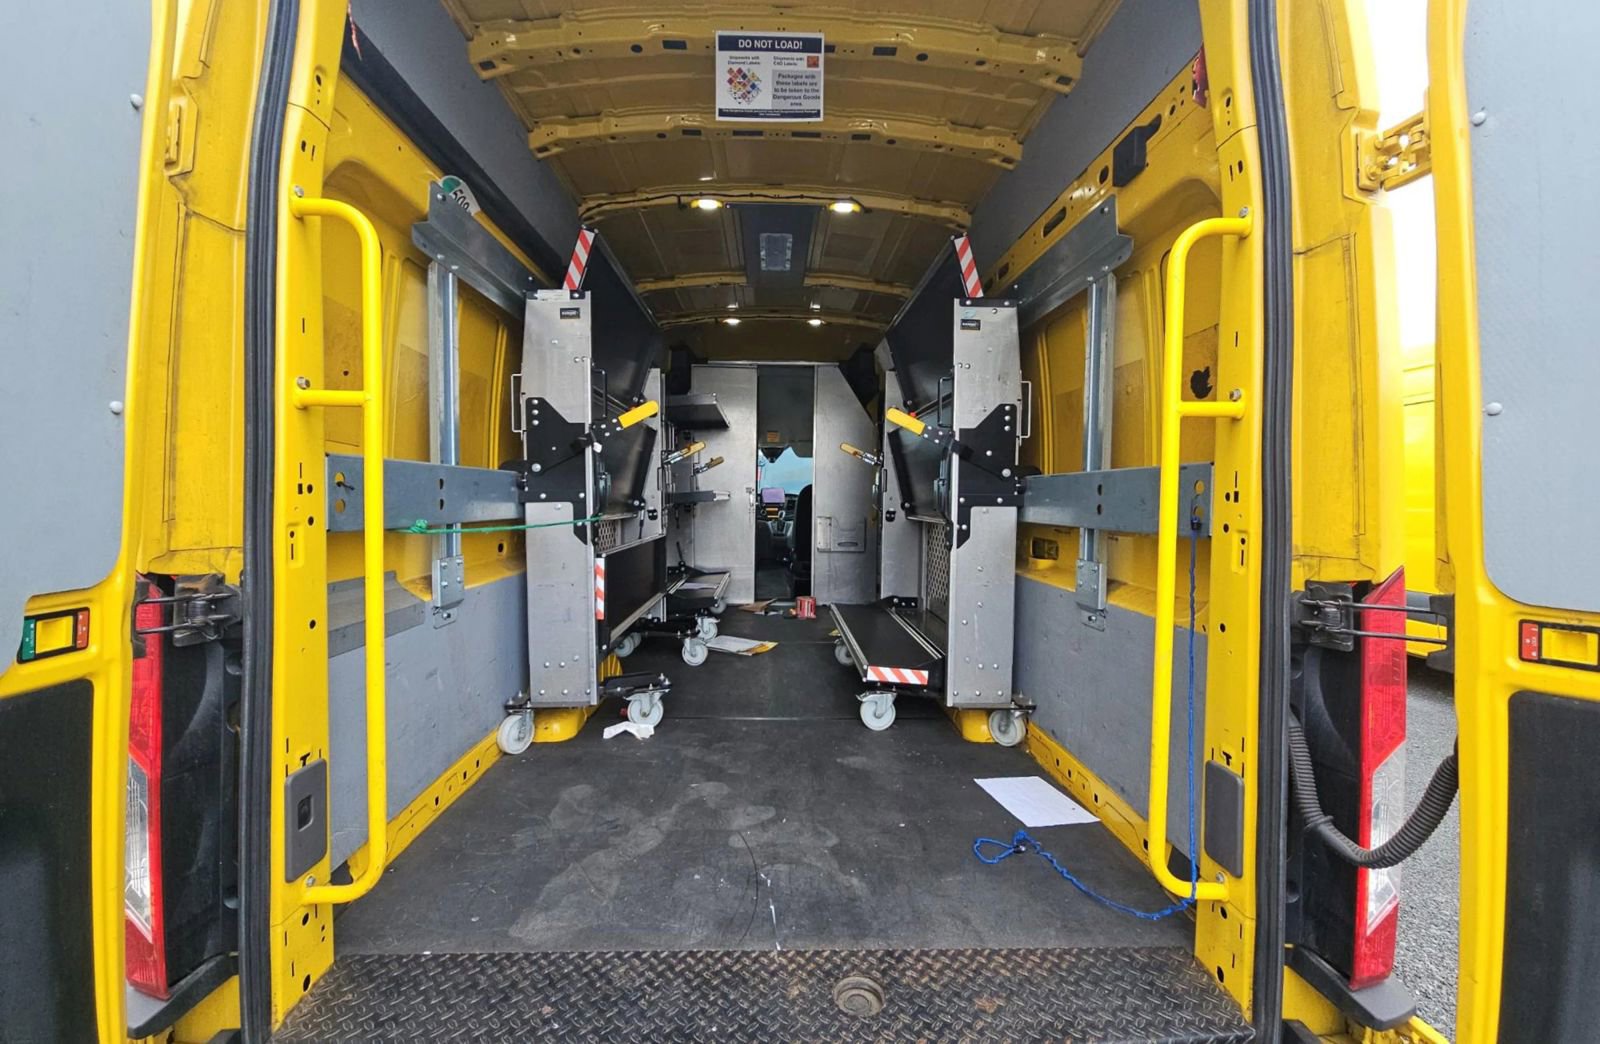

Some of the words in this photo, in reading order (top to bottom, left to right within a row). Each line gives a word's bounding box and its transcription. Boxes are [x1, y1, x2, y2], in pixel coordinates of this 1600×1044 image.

[738, 39, 752, 49] DO
[754, 39, 773, 49] NOT
[775, 40, 803, 50] LOAD!
